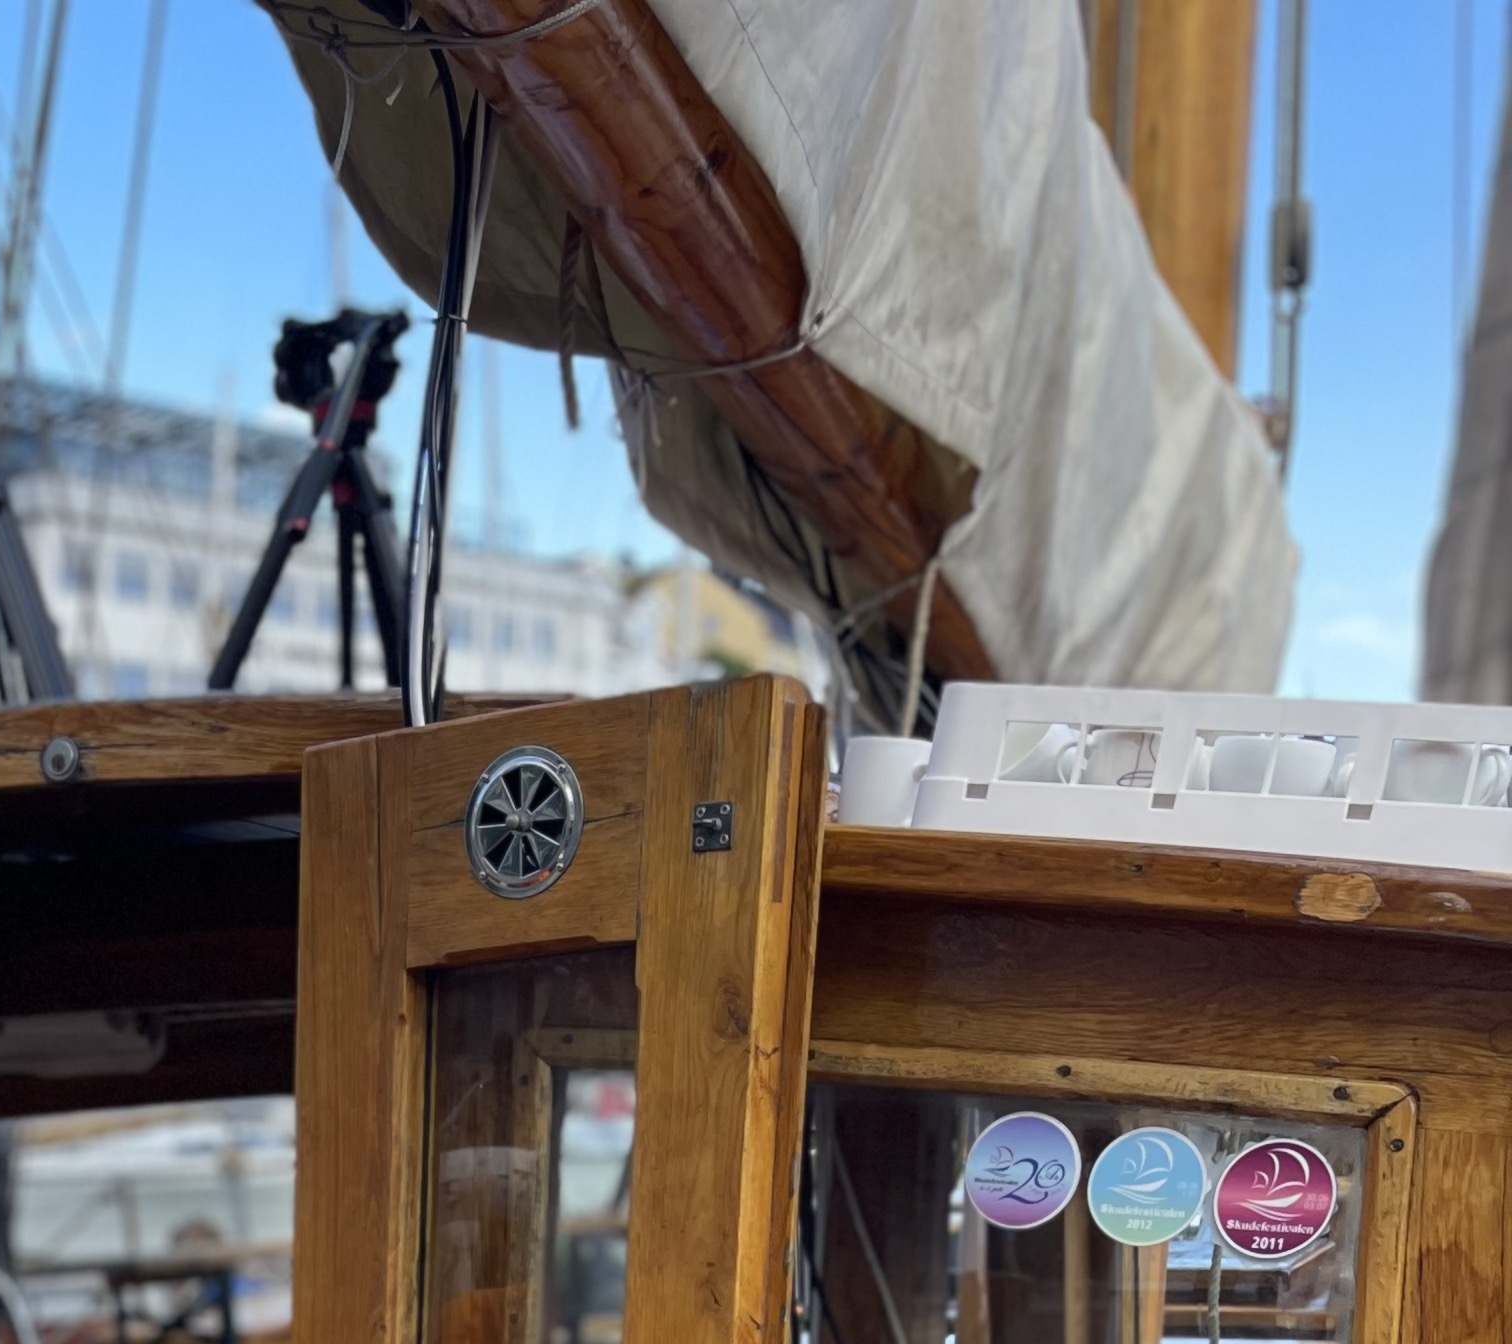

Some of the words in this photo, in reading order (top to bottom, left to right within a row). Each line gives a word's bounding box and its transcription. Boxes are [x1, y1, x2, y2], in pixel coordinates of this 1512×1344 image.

[1125, 1218, 1153, 1231] 2012
[1226, 1219, 1314, 1235] Skudefestivalen
[1251, 1236, 1284, 1251] 2011
